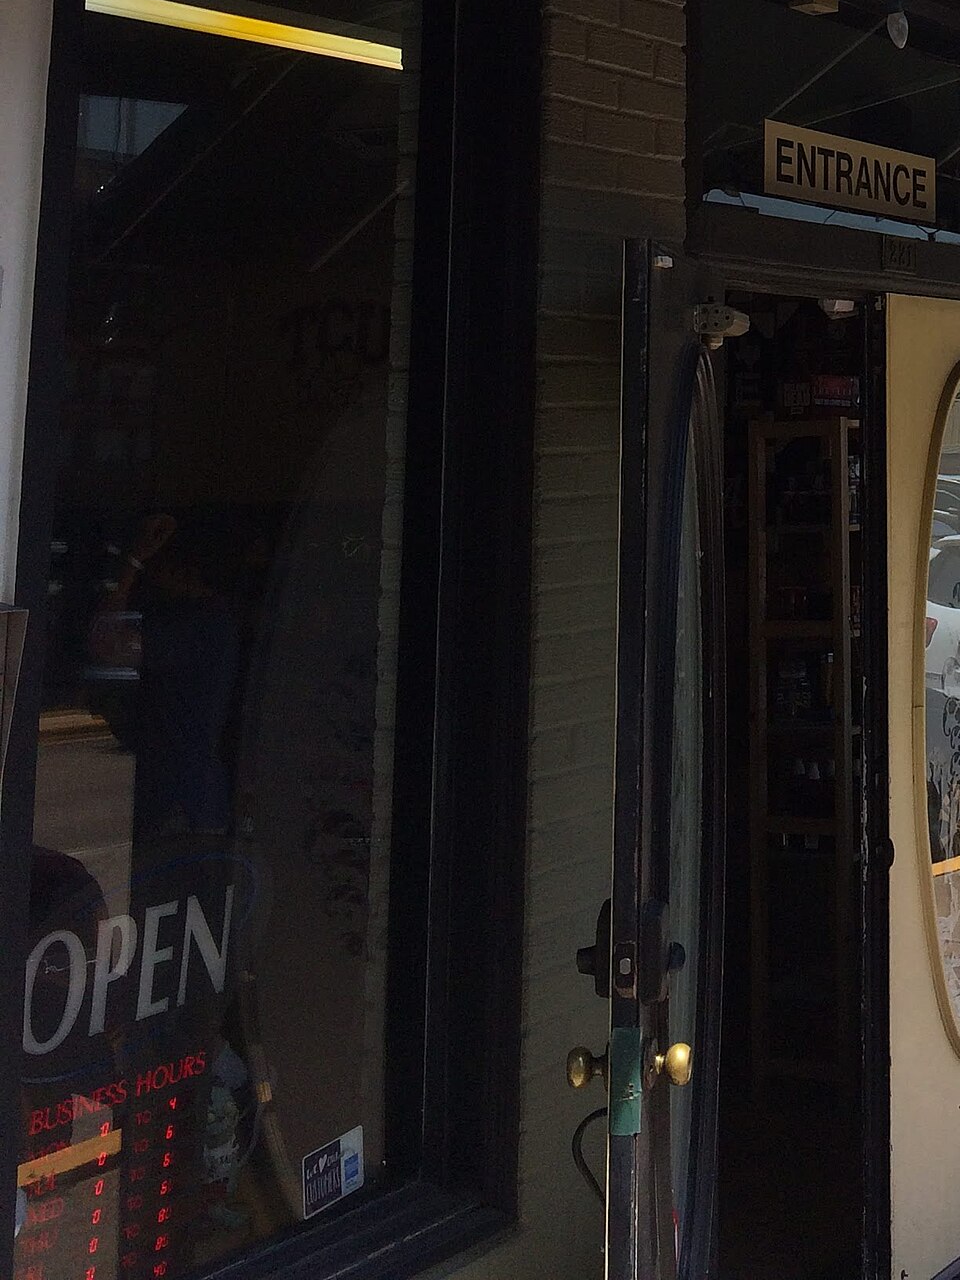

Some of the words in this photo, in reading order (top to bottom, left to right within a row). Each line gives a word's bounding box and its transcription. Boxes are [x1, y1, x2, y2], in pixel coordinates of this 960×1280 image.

[776, 137, 927, 209] ENTRANCE
[22, 884, 236, 1055] OPEN
[28, 1080, 128, 1137] BUSINESS
[135, 1052, 206, 1097] HOURS
